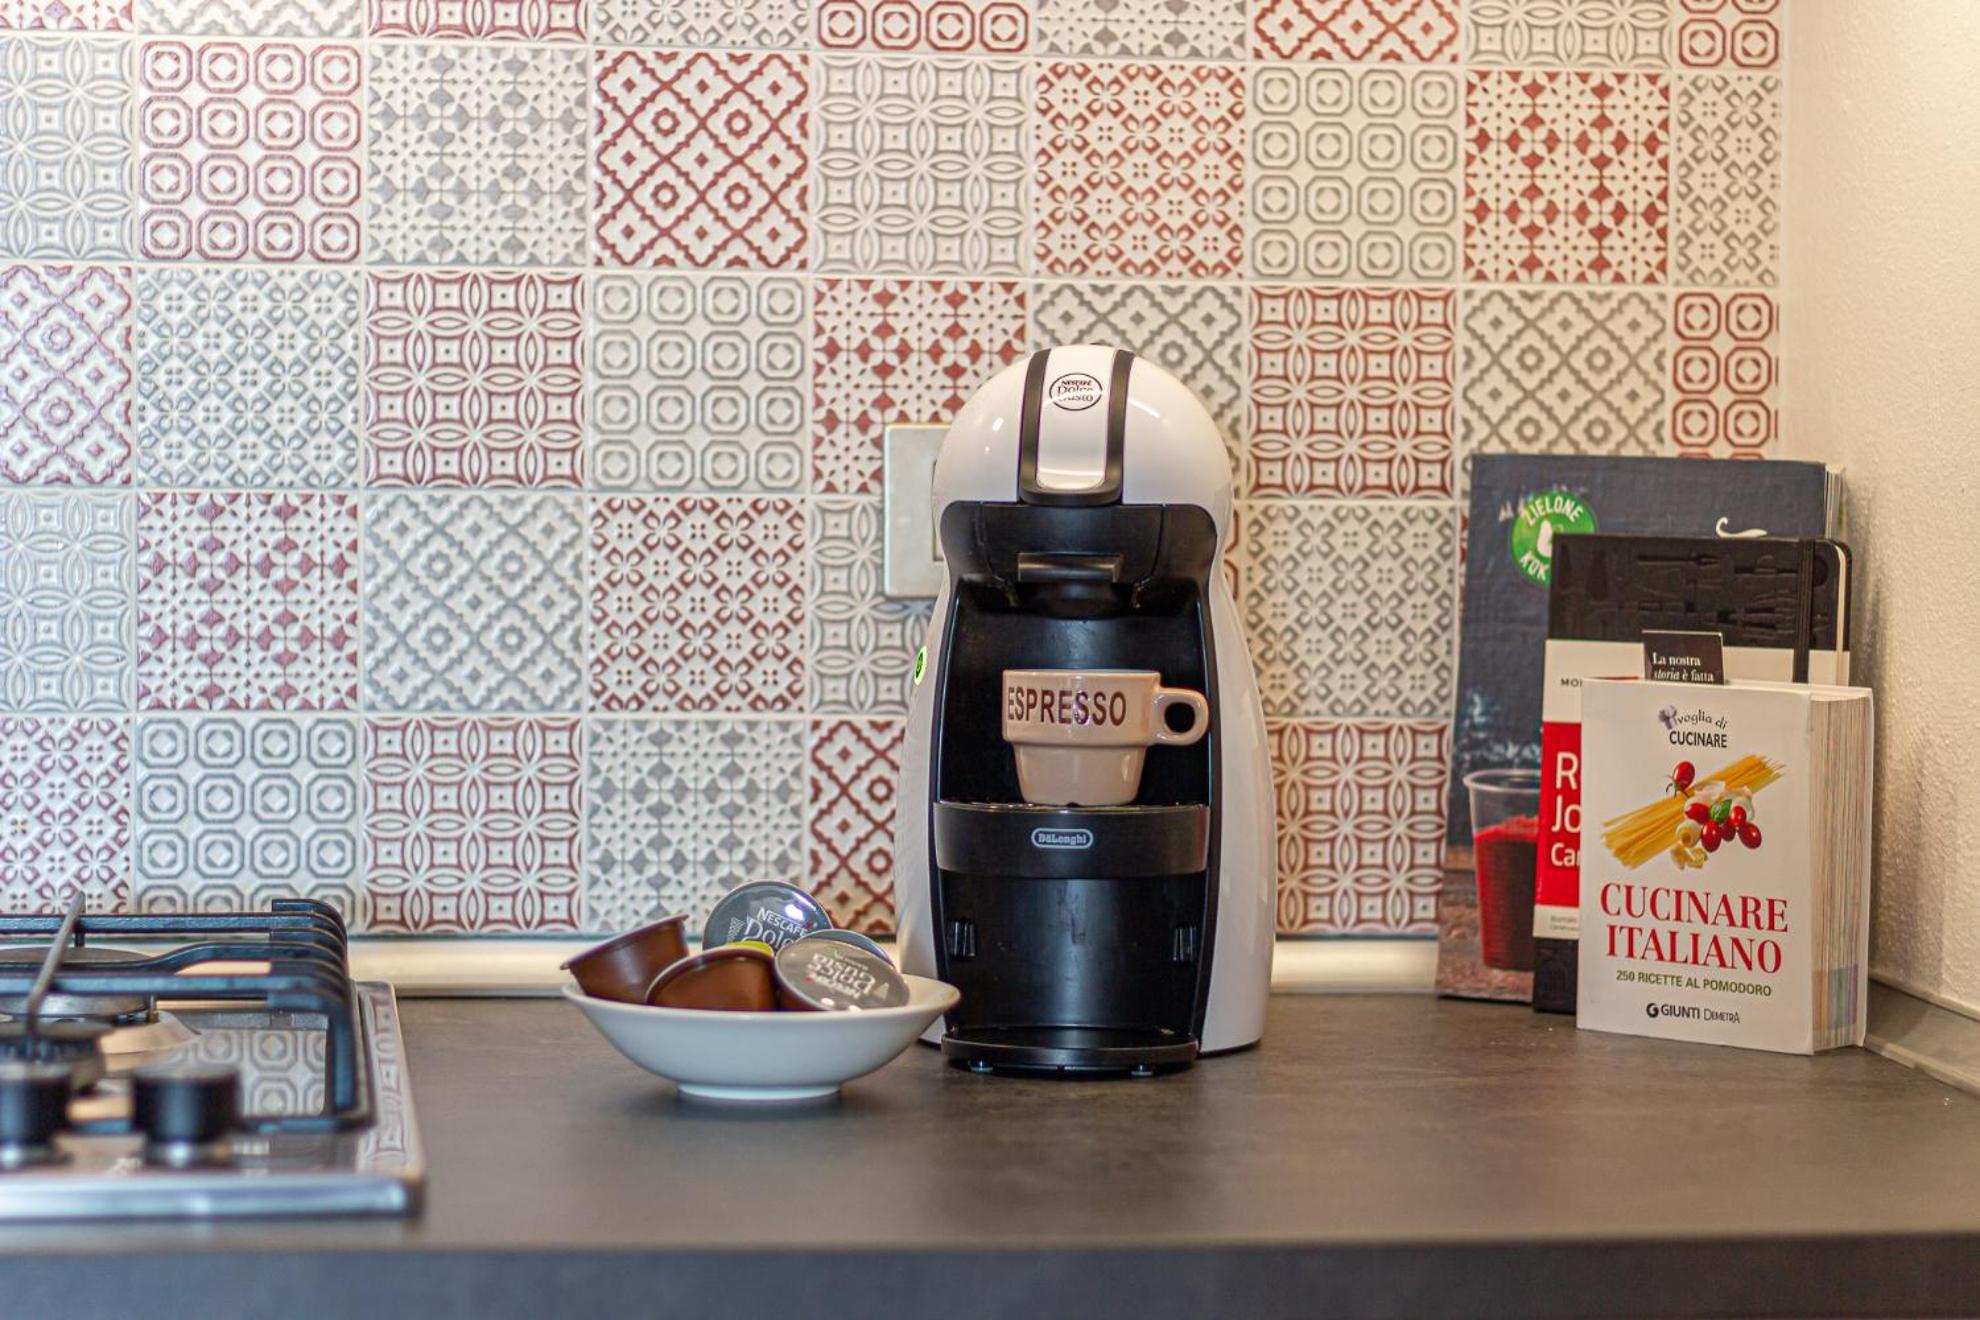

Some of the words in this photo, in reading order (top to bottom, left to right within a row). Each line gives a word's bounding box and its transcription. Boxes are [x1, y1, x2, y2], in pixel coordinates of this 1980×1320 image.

[1526, 496, 1584, 526] ZIELONE
[1520, 551, 1550, 581] KOK
[1652, 652, 1667, 666] La
[1668, 655, 1701, 667] nostra
[1654, 668, 1680, 681] storia
[1691, 670, 1715, 682] fatta
[1008, 687, 1126, 726] ESPRESSO
[1678, 709, 1713, 728] voglia
[1716, 716, 1728, 730] di
[1669, 731, 1728, 748] CUCINARE
[1556, 752, 1579, 790] R
[1551, 795, 1581, 833] Jo
[1600, 882, 1789, 932] CUCINARE
[1607, 924, 1782, 974] ITALIANO
[1616, 970, 1635, 983] 250
[1638, 972, 1682, 988] RICETTE
[1685, 977, 1700, 990] AL
[1703, 979, 1772, 997] POMODORO
[1660, 1004, 1700, 1019] GIUNTI
